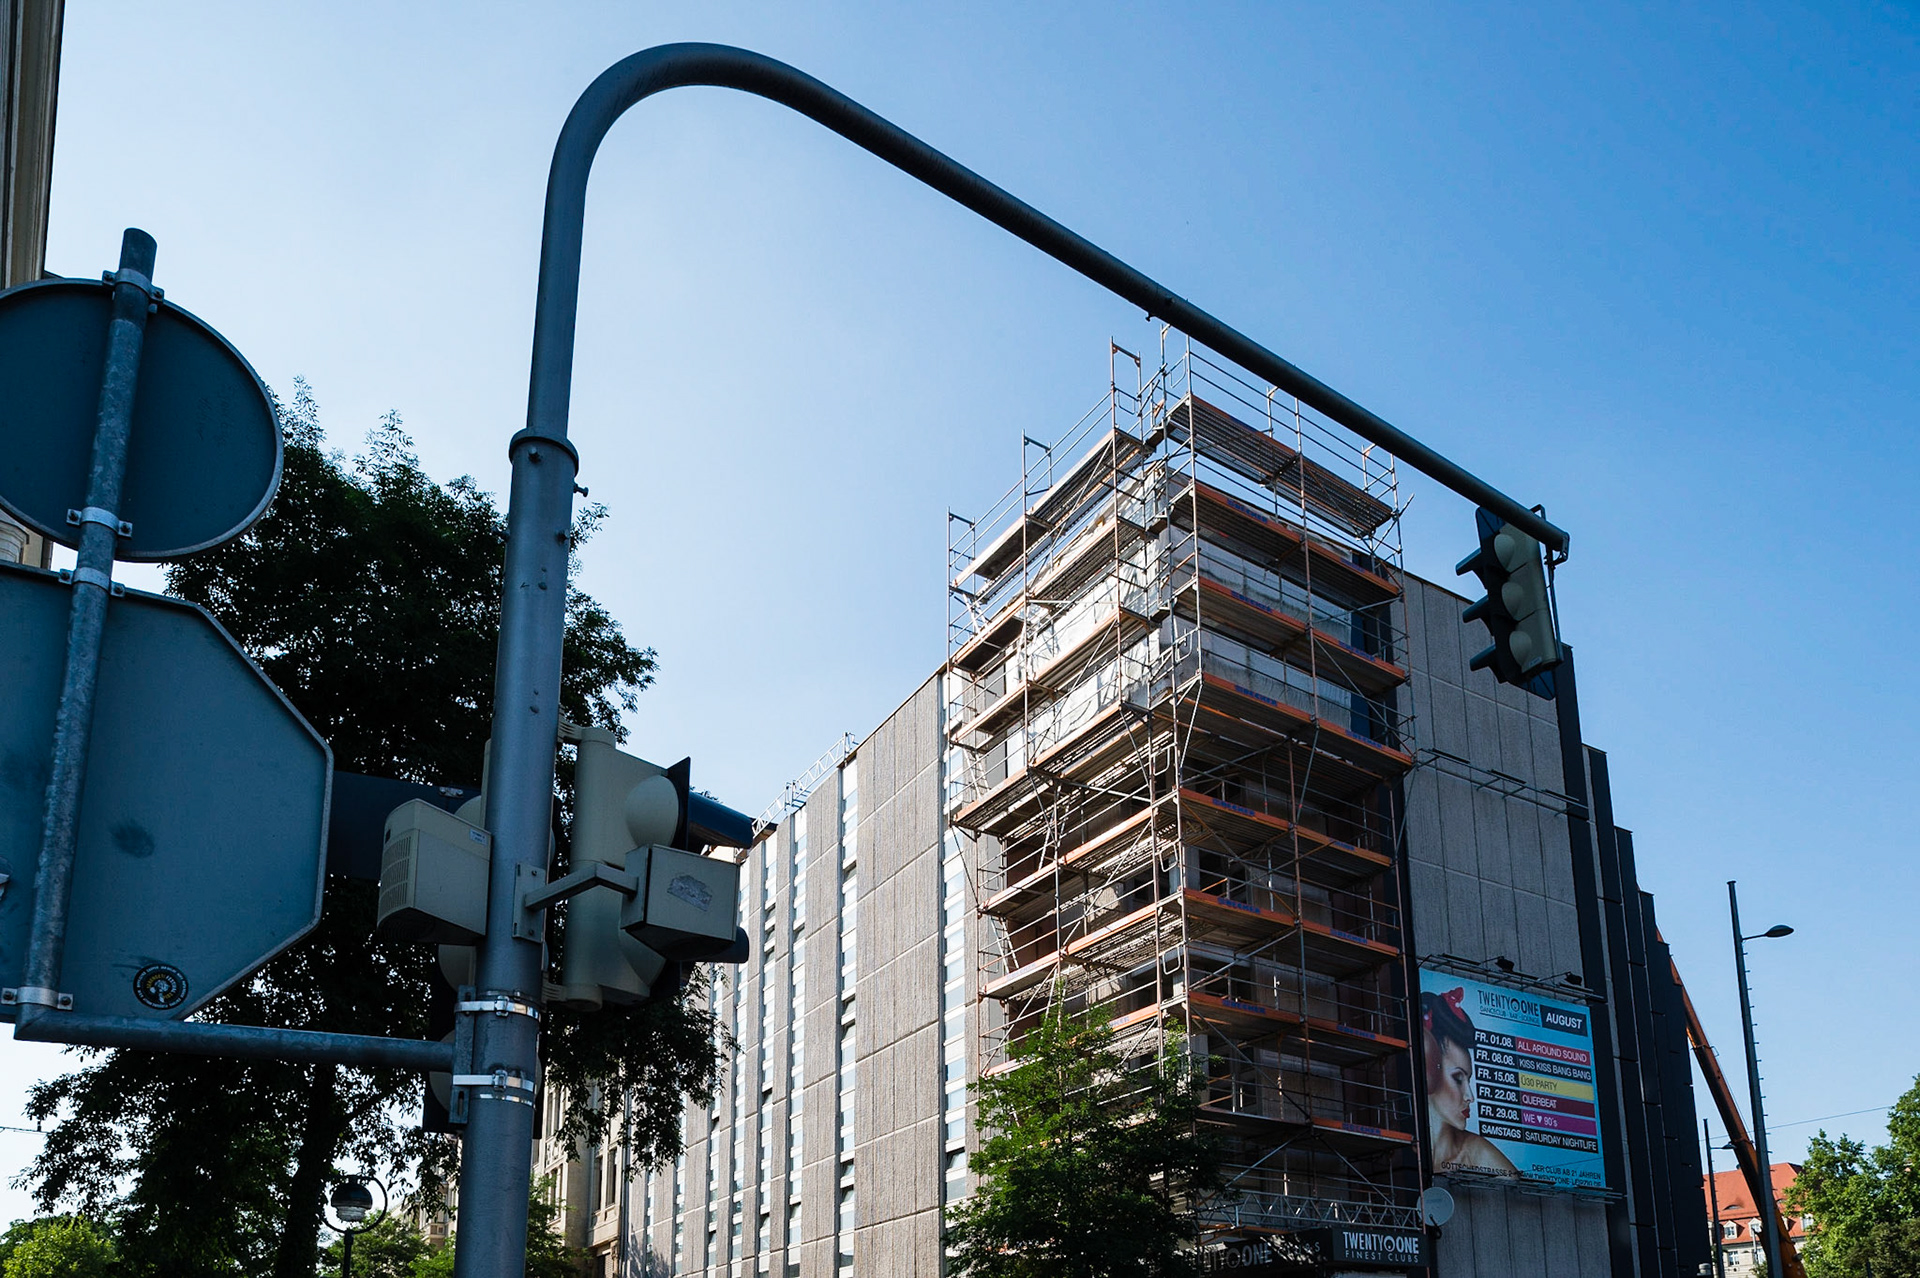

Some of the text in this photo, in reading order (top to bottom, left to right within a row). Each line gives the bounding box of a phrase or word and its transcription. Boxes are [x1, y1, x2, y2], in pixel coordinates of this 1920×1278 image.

[1546, 1013, 1583, 1029] AUGUST
[1475, 1031, 1587, 1063] FR. 01.08. ALL AROUND SOUND
[1476, 1049, 1592, 1080] FR. 08.08. KISS KISS BANG BANG
[1477, 1068, 1558, 1091] FR. 15.08. Ü30 PARTY
[1479, 1086, 1557, 1108] FR. 22.08. QUERBEAT
[1480, 1105, 1494, 1117] FR.
[1496, 1107, 1519, 1120] 29.08.
[1523, 1113, 1536, 1124] WE
[1481, 1124, 1597, 1151] SAMSTAGS SATURDAY NIGHTLIFE
[1532, 1163, 1545, 1172] DER
[1545, 1165, 1562, 1175] CLUB
[1579, 1171, 1602, 1180] JAHREN
[1345, 1251, 1419, 1263] FINEST CLUBS
